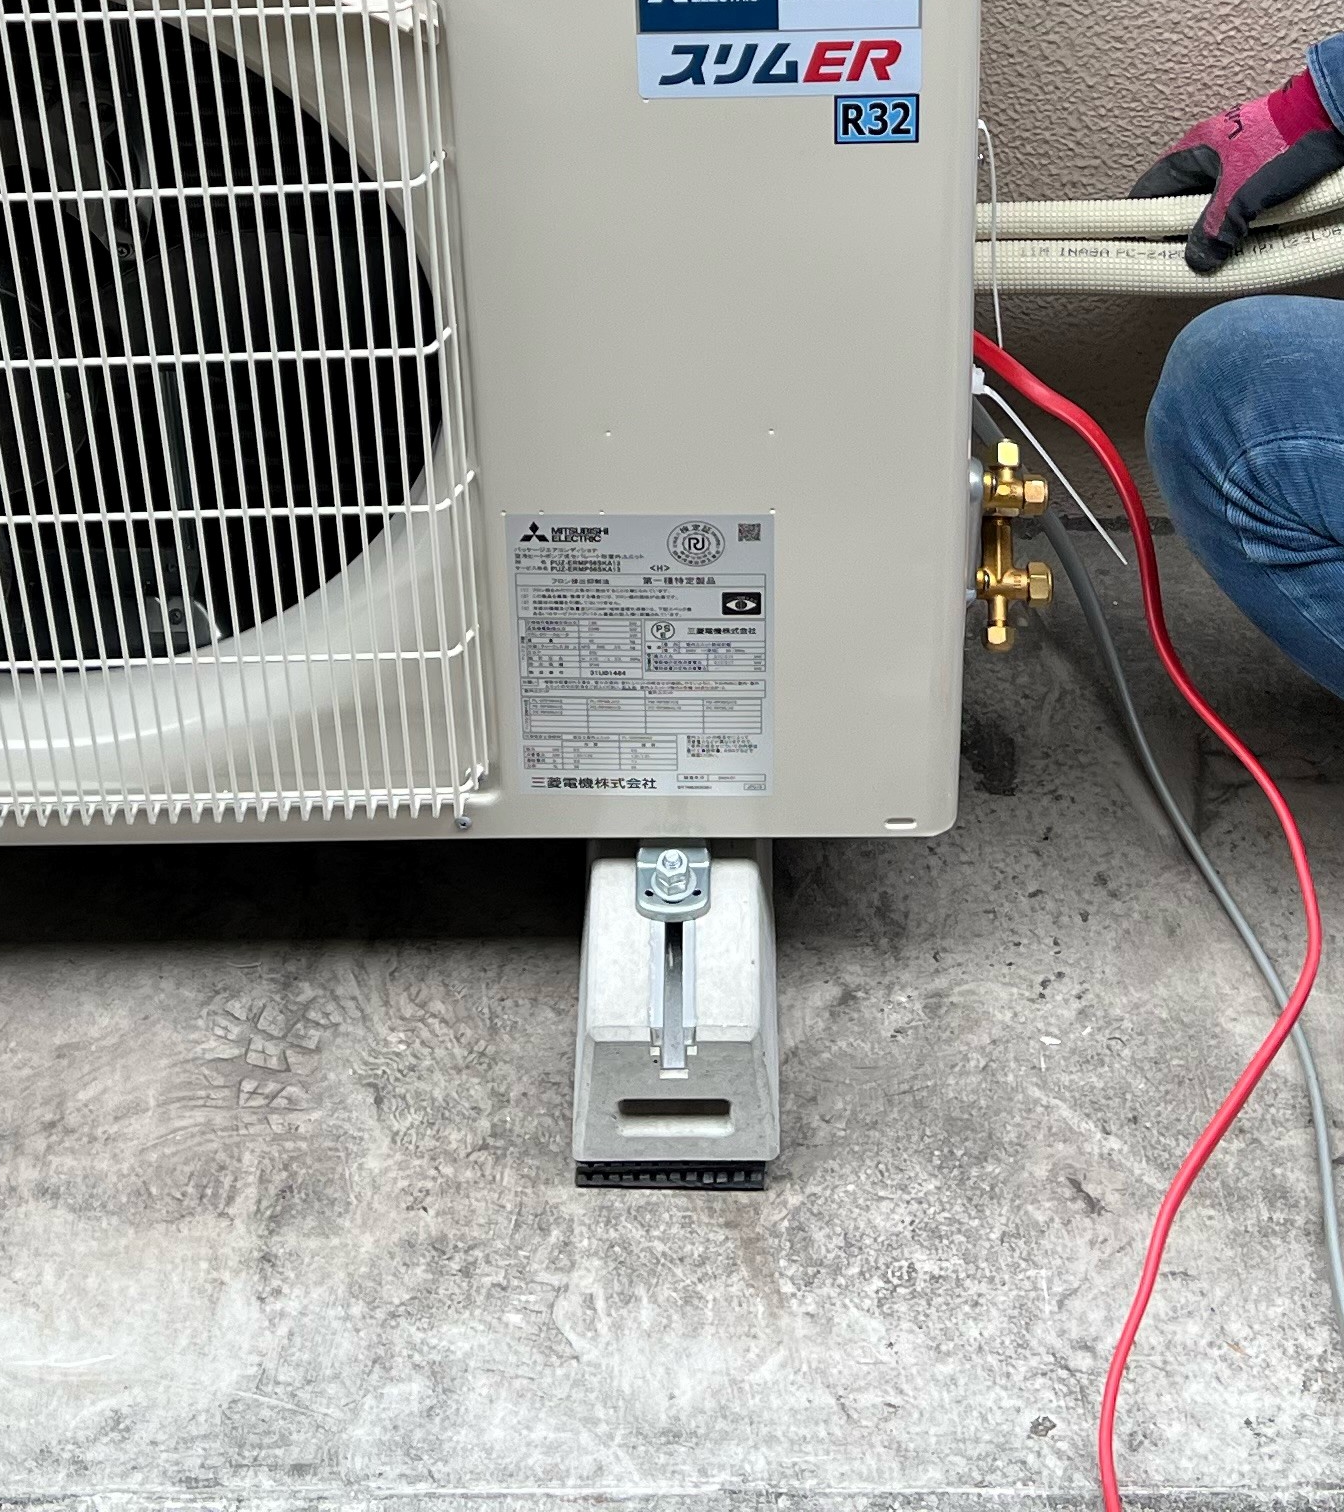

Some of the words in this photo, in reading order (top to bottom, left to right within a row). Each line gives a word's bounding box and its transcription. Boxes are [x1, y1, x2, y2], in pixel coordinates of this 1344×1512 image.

[840, 101, 912, 137] R32
[551, 527, 609, 535] MITSUBISHI
[551, 535, 601, 543] ELECTRIC
[642, 576, 716, 585] 第一種特定製品
[531, 776, 658, 789] 三菱電機株式会社
